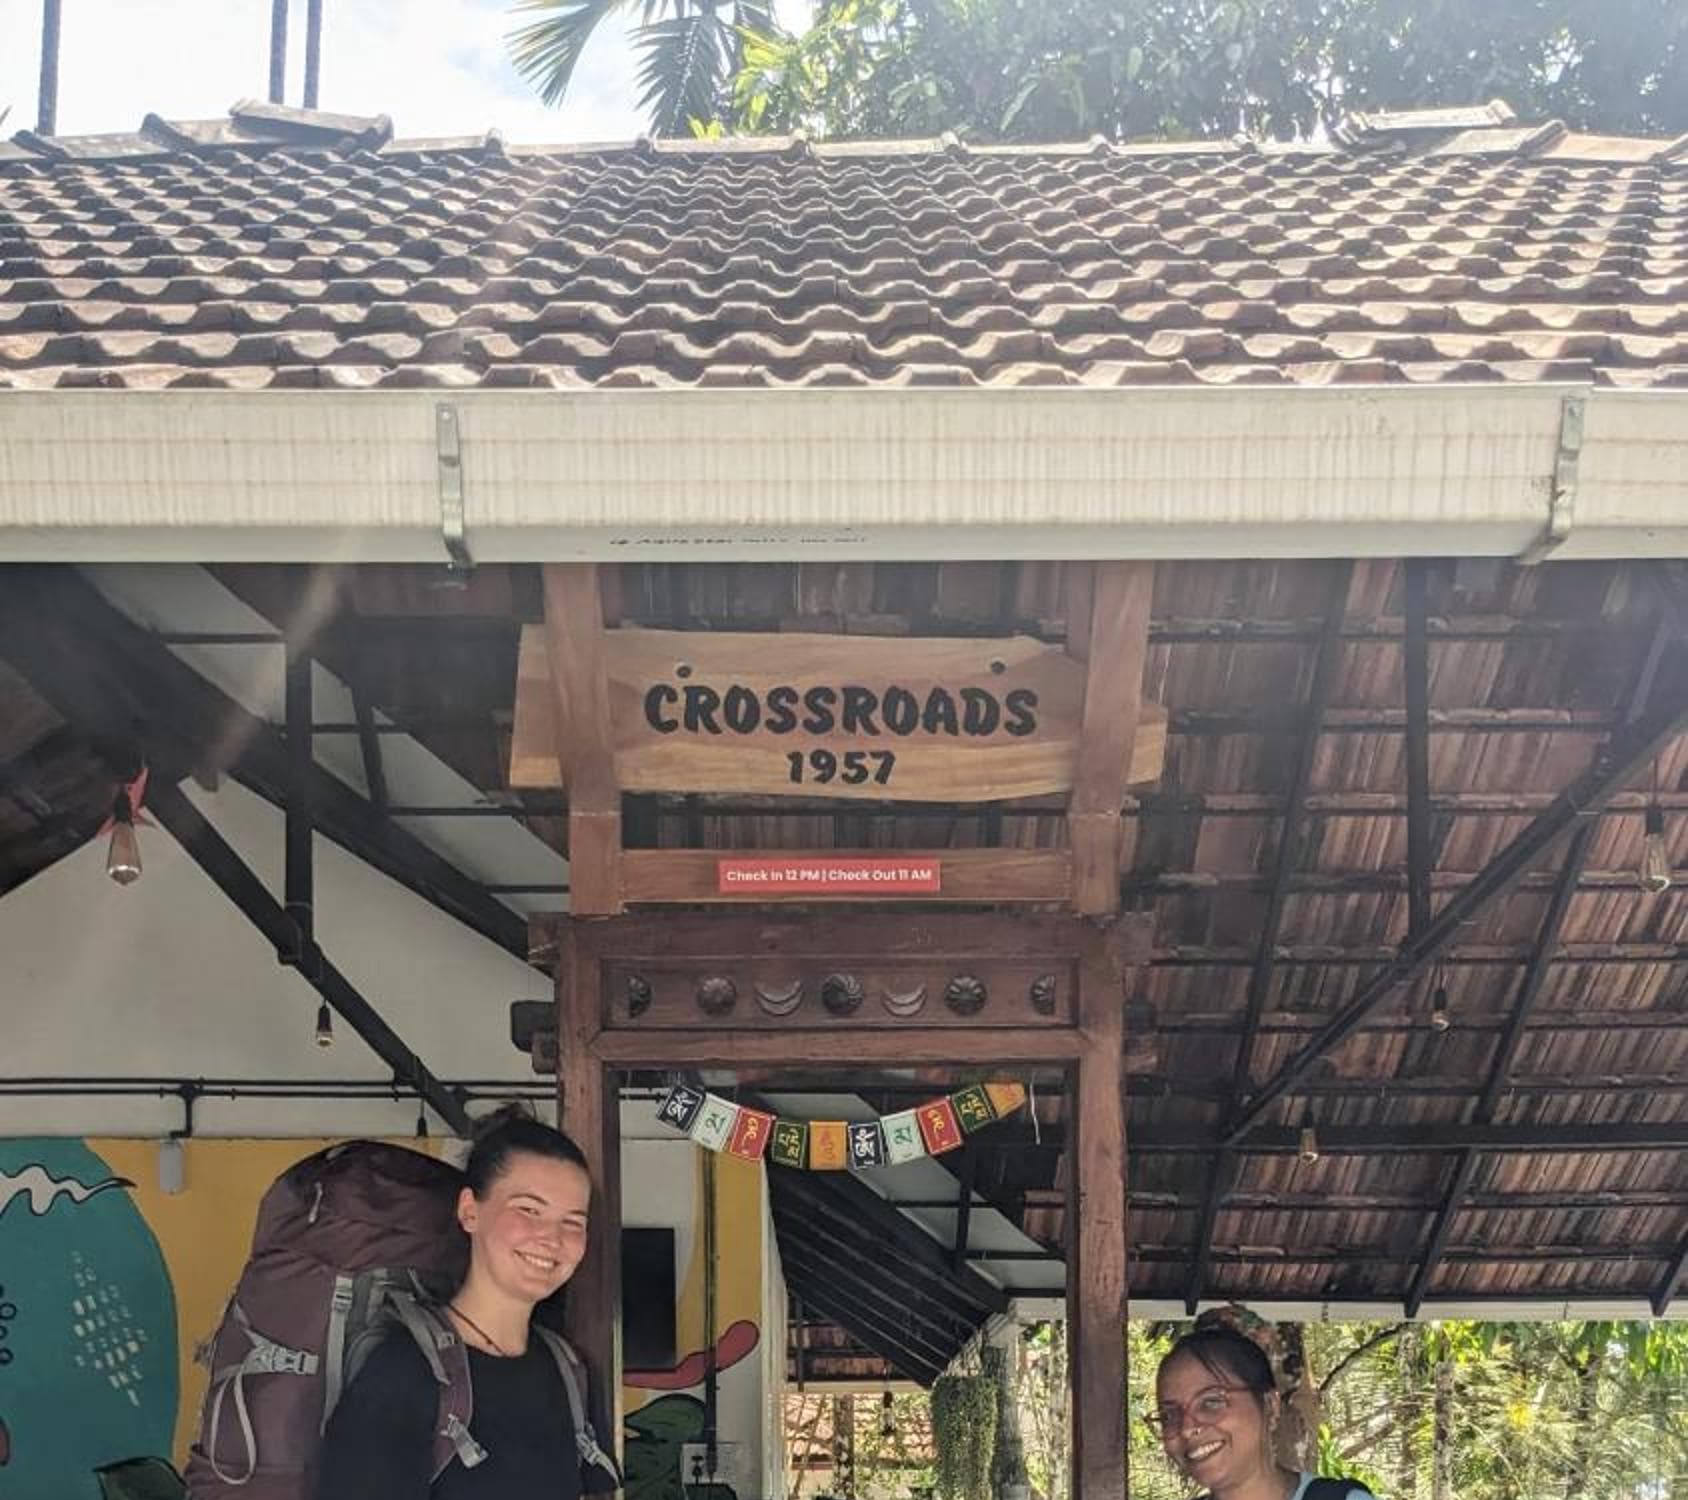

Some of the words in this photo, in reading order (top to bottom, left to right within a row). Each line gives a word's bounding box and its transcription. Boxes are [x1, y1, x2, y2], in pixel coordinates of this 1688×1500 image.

[644, 684, 1038, 736] CROSSROADS
[787, 749, 896, 785] 1957
[727, 869, 769, 881] Check
[785, 869, 797, 881] 12
[799, 869, 820, 881] PM
[828, 869, 871, 881] Check
[872, 869, 897, 881] Out
[911, 869, 932, 881] AM
